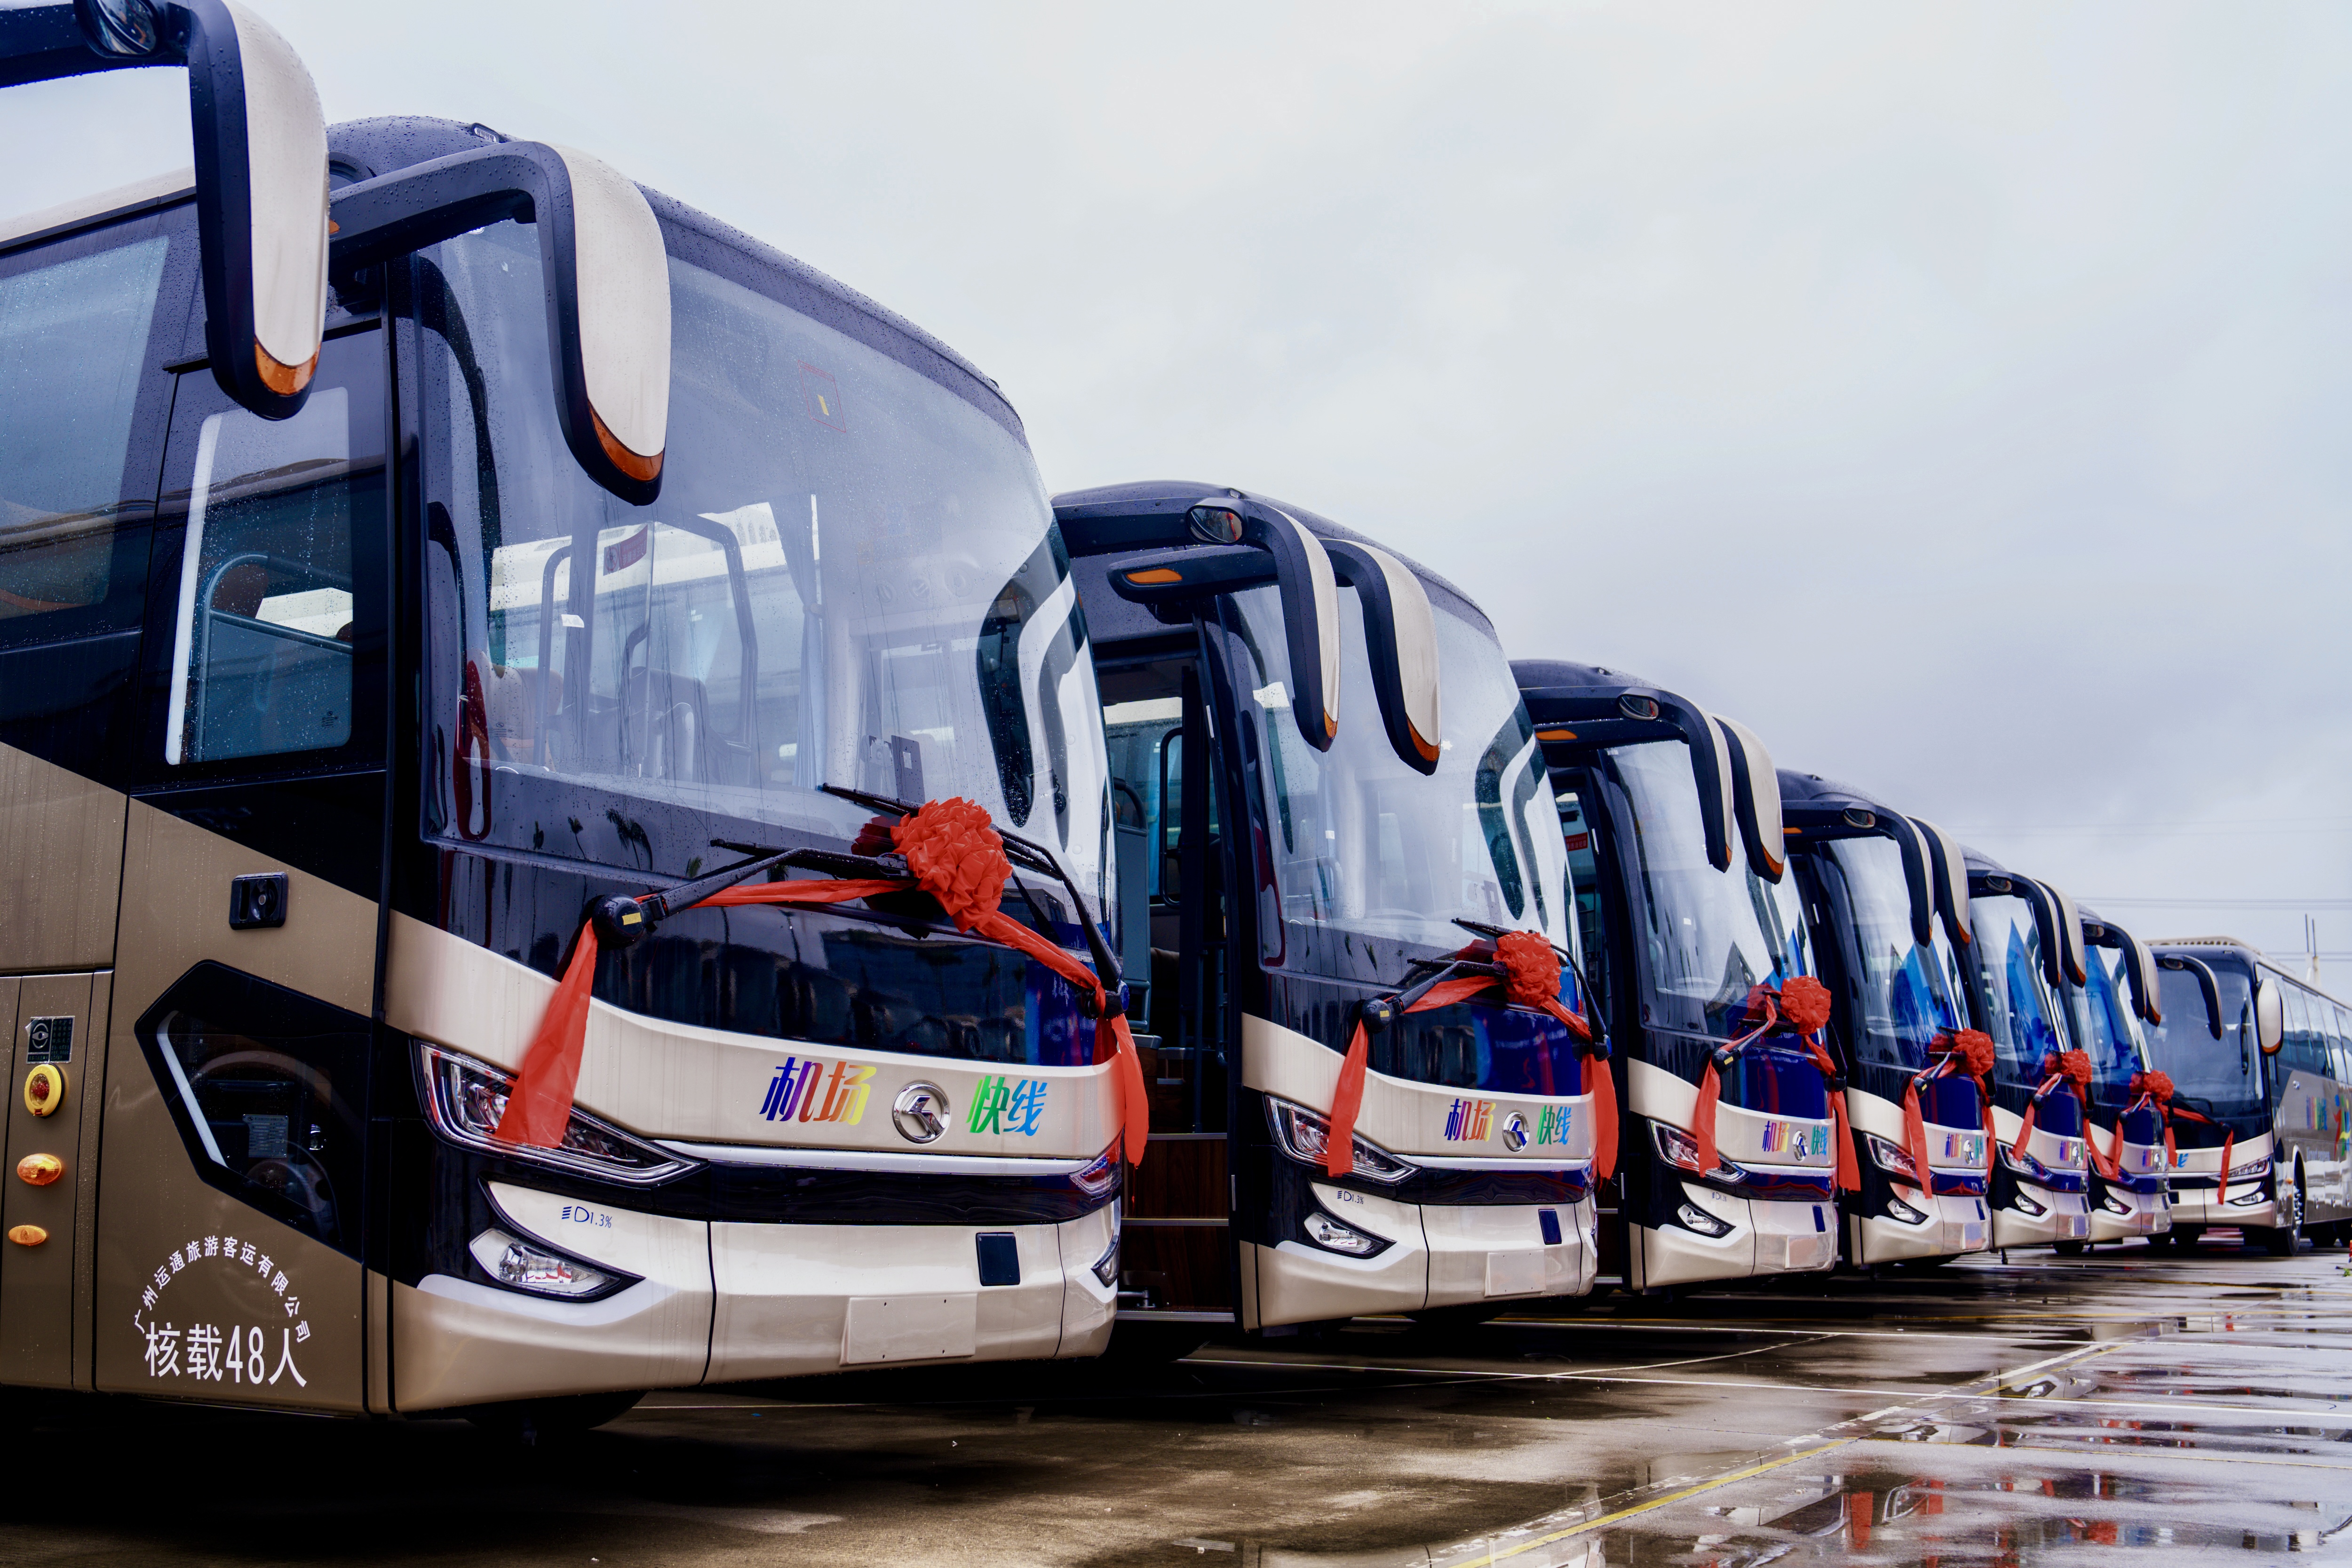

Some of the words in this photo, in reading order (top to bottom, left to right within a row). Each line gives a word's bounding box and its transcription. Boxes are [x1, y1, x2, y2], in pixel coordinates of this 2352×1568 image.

[759, 1057, 877, 1126] 机场
[965, 1075, 1048, 1136] 快线
[1444, 1098, 1496, 1142] 机场
[1536, 1105, 1572, 1145] 快线
[1762, 1121, 1790, 1153] 机场
[135, 1235, 311, 1343] 广州运通旅游客运有限公司
[144, 1321, 307, 1387] 核载48人
